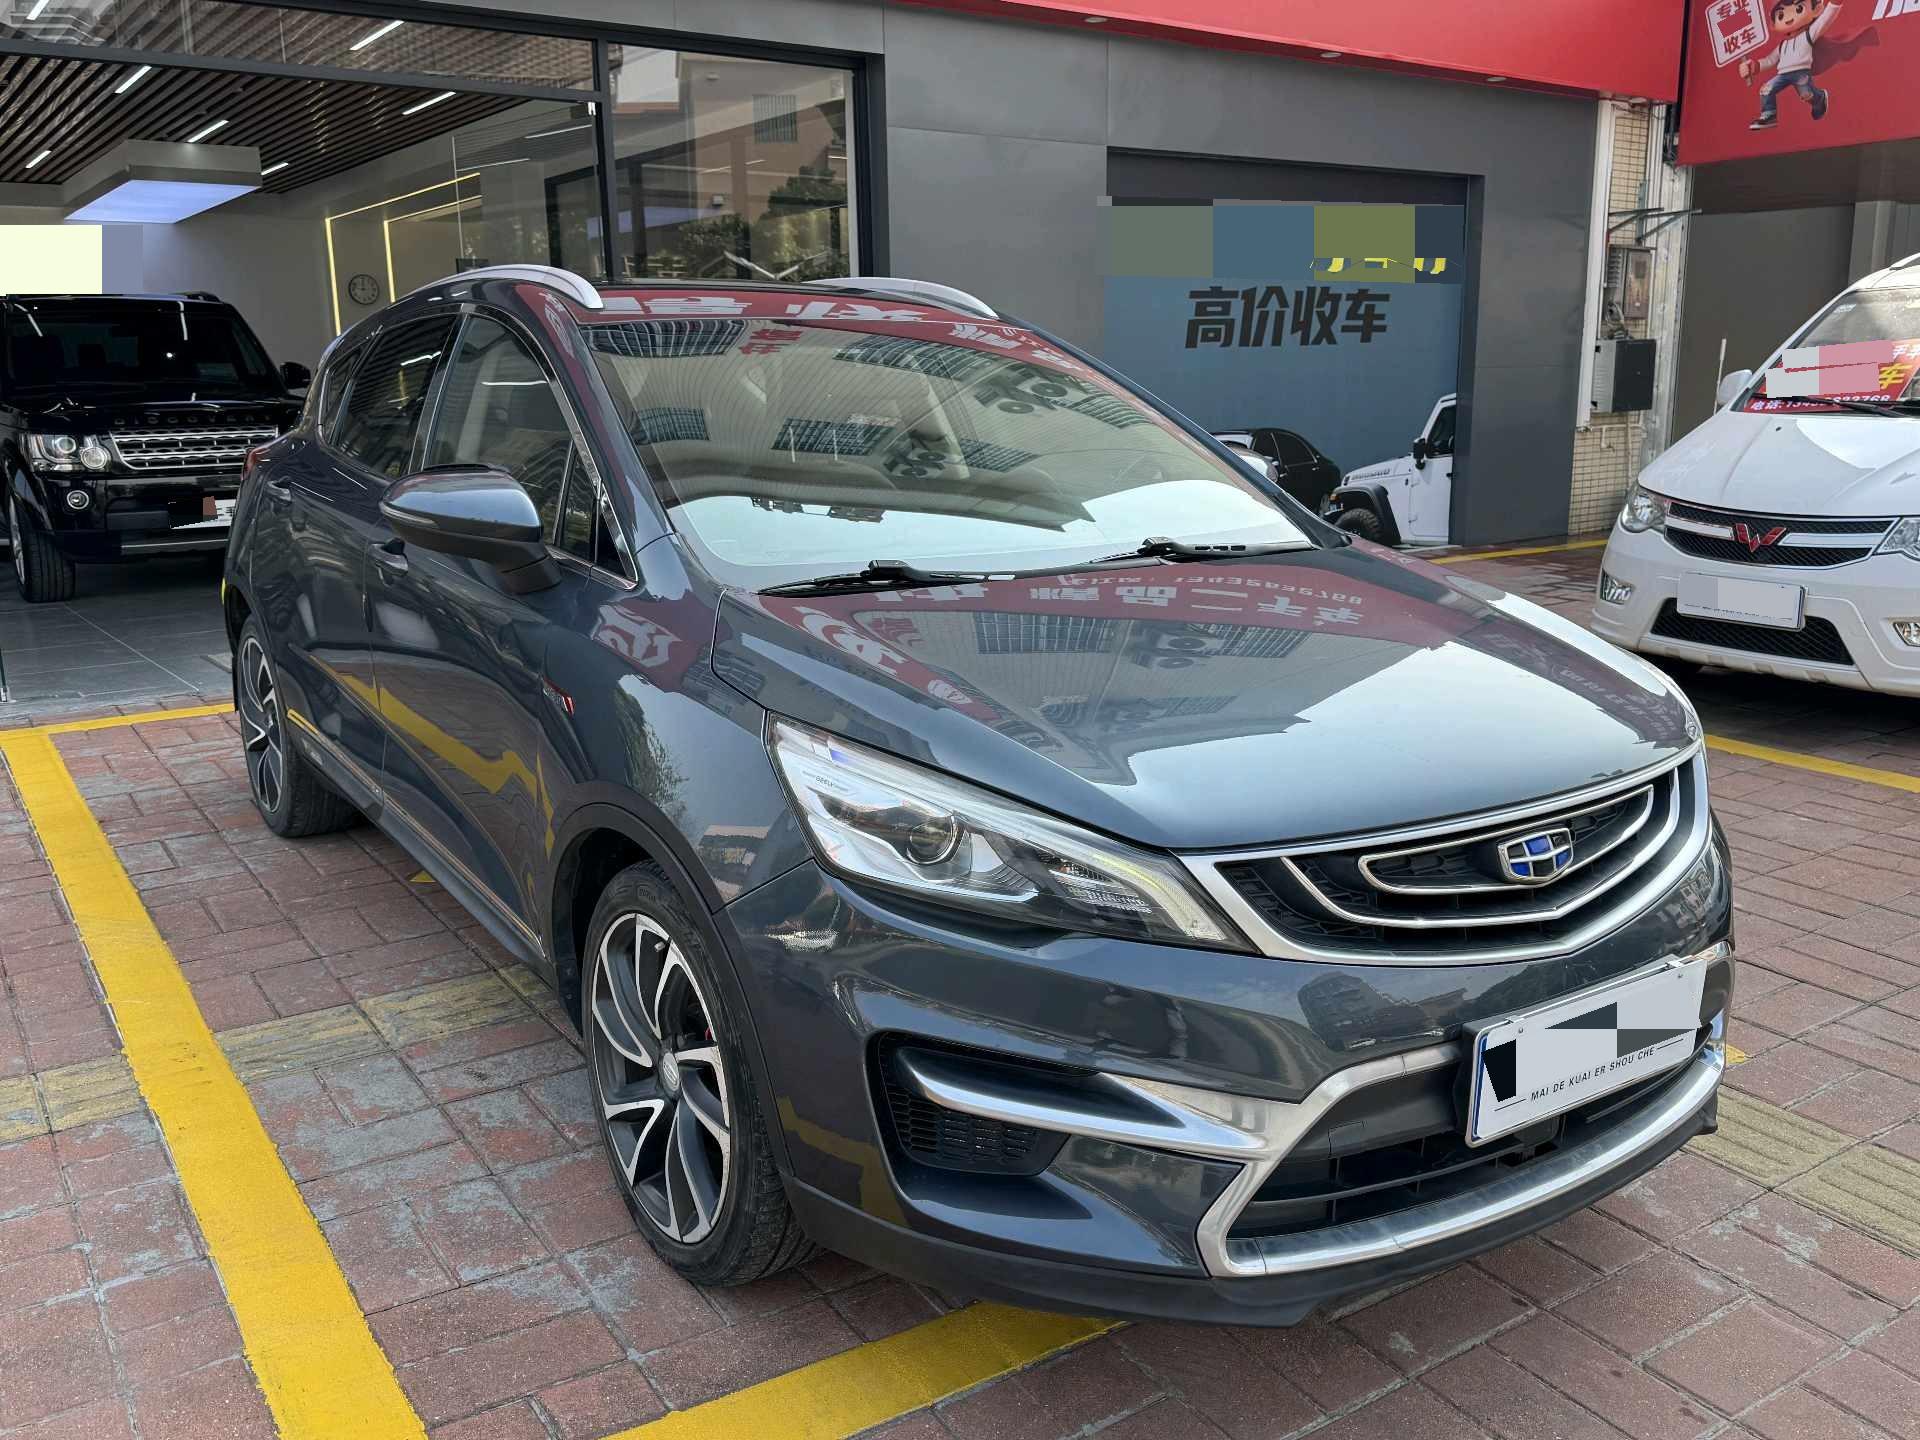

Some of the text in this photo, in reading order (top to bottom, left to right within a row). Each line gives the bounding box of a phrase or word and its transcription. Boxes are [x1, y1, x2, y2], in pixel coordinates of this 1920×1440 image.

[1185, 286, 1390, 349] 高价收车
[1531, 1088, 1549, 1101] MAI
[1553, 1080, 1565, 1093] DE
[1595, 1066, 1606, 1077] ER
[1610, 1054, 1634, 1071] SHOU
[1638, 1047, 1655, 1060] CHE
